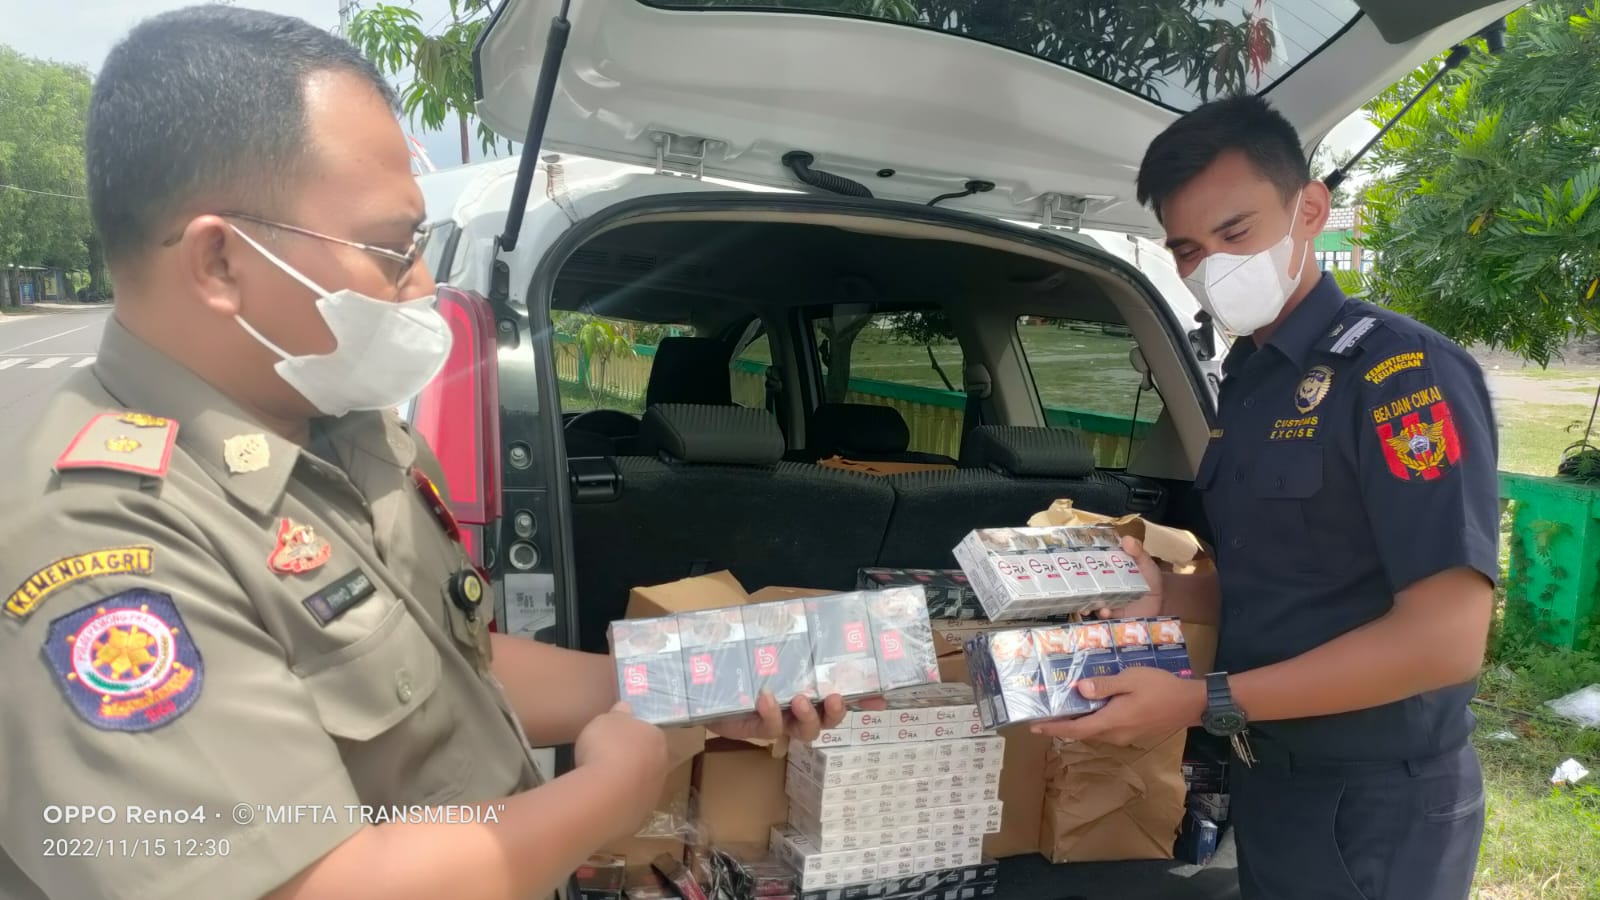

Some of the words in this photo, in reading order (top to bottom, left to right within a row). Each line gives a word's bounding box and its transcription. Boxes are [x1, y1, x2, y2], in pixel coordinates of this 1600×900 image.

[1364, 352, 1424, 381] KEMENTERIAN
[1373, 360, 1421, 384] KEUANGAN
[1373, 405, 1392, 423] BEA
[1391, 396, 1412, 417] DAN
[1411, 385, 1442, 408] CUKAI
[1270, 428, 1315, 439] EXCISE
[1274, 416, 1319, 428] CUSTOMS
[12, 551, 142, 609] KEMENDAGRI
